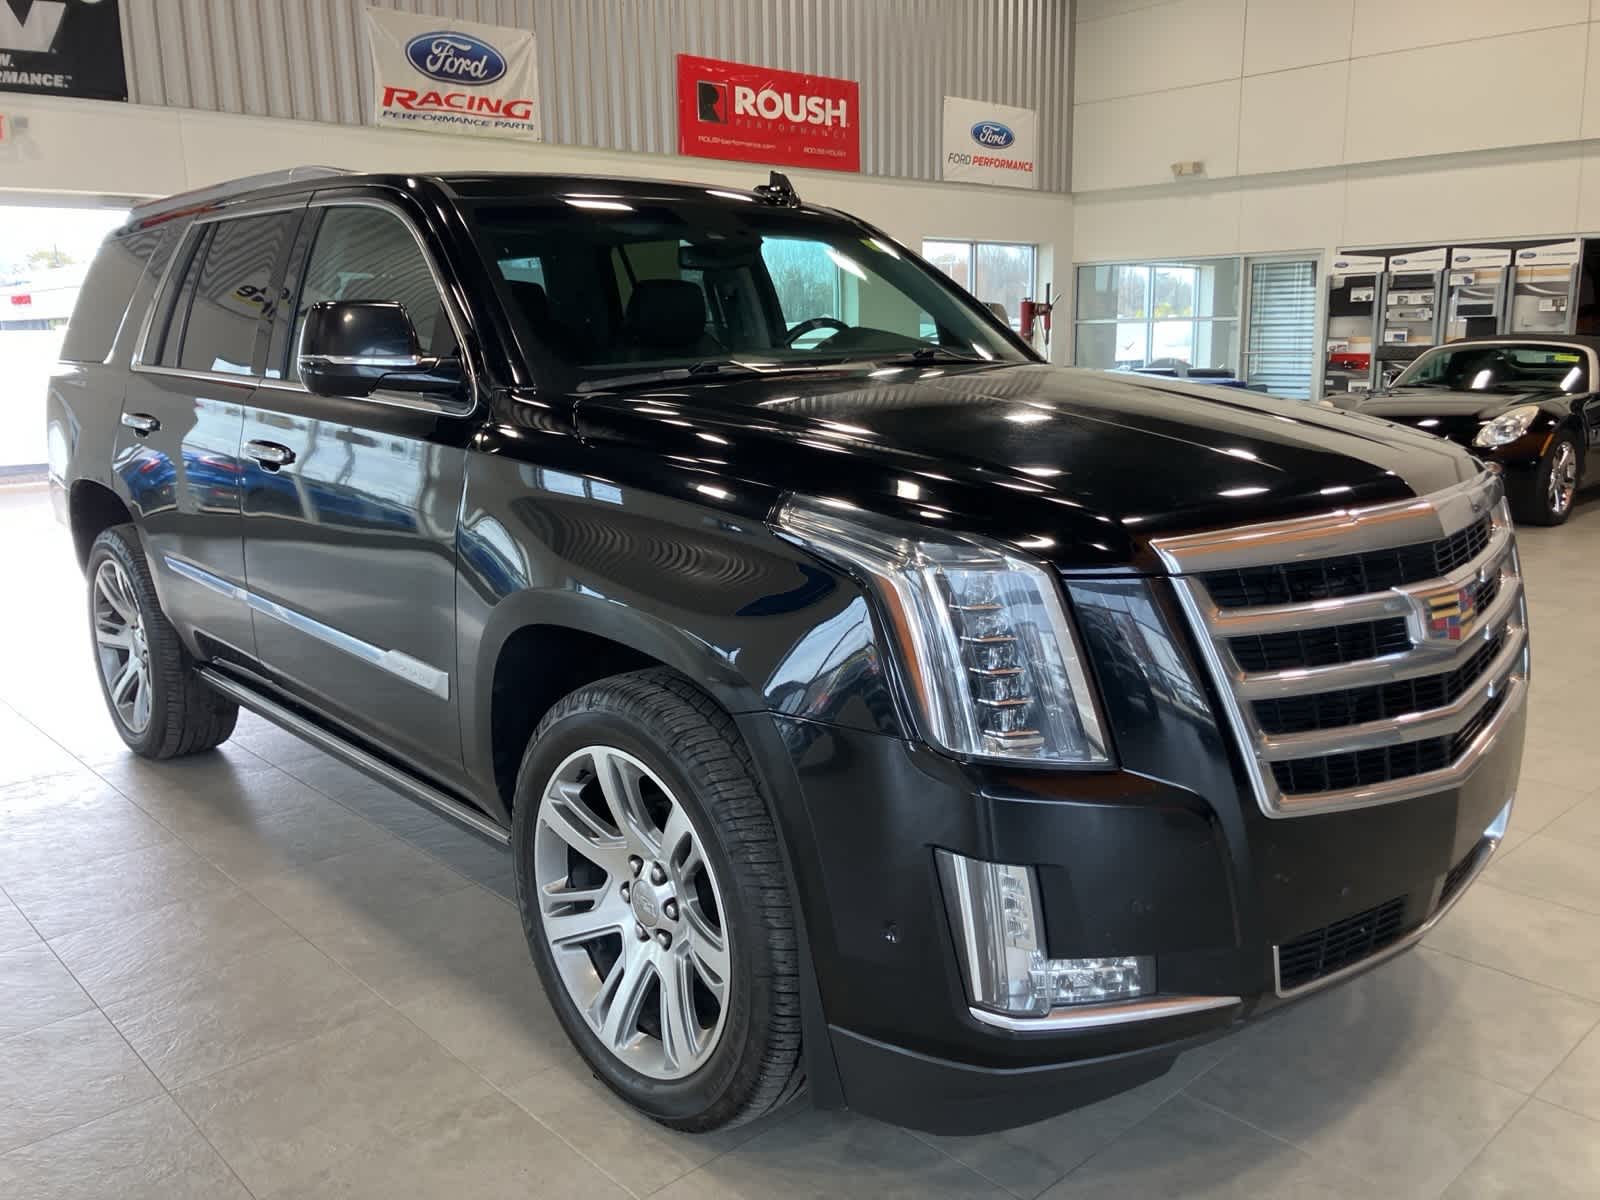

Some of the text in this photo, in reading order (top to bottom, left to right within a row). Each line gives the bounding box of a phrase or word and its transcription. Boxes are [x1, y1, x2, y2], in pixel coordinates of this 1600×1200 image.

[426, 38, 489, 79] Ford
[382, 86, 534, 120] RACING
[734, 80, 847, 128] ROUSH
[382, 110, 534, 131] PERFORMANCE PARTS
[979, 125, 1007, 145] Ford
[948, 152, 1034, 173] FORD PERFORMANCE
